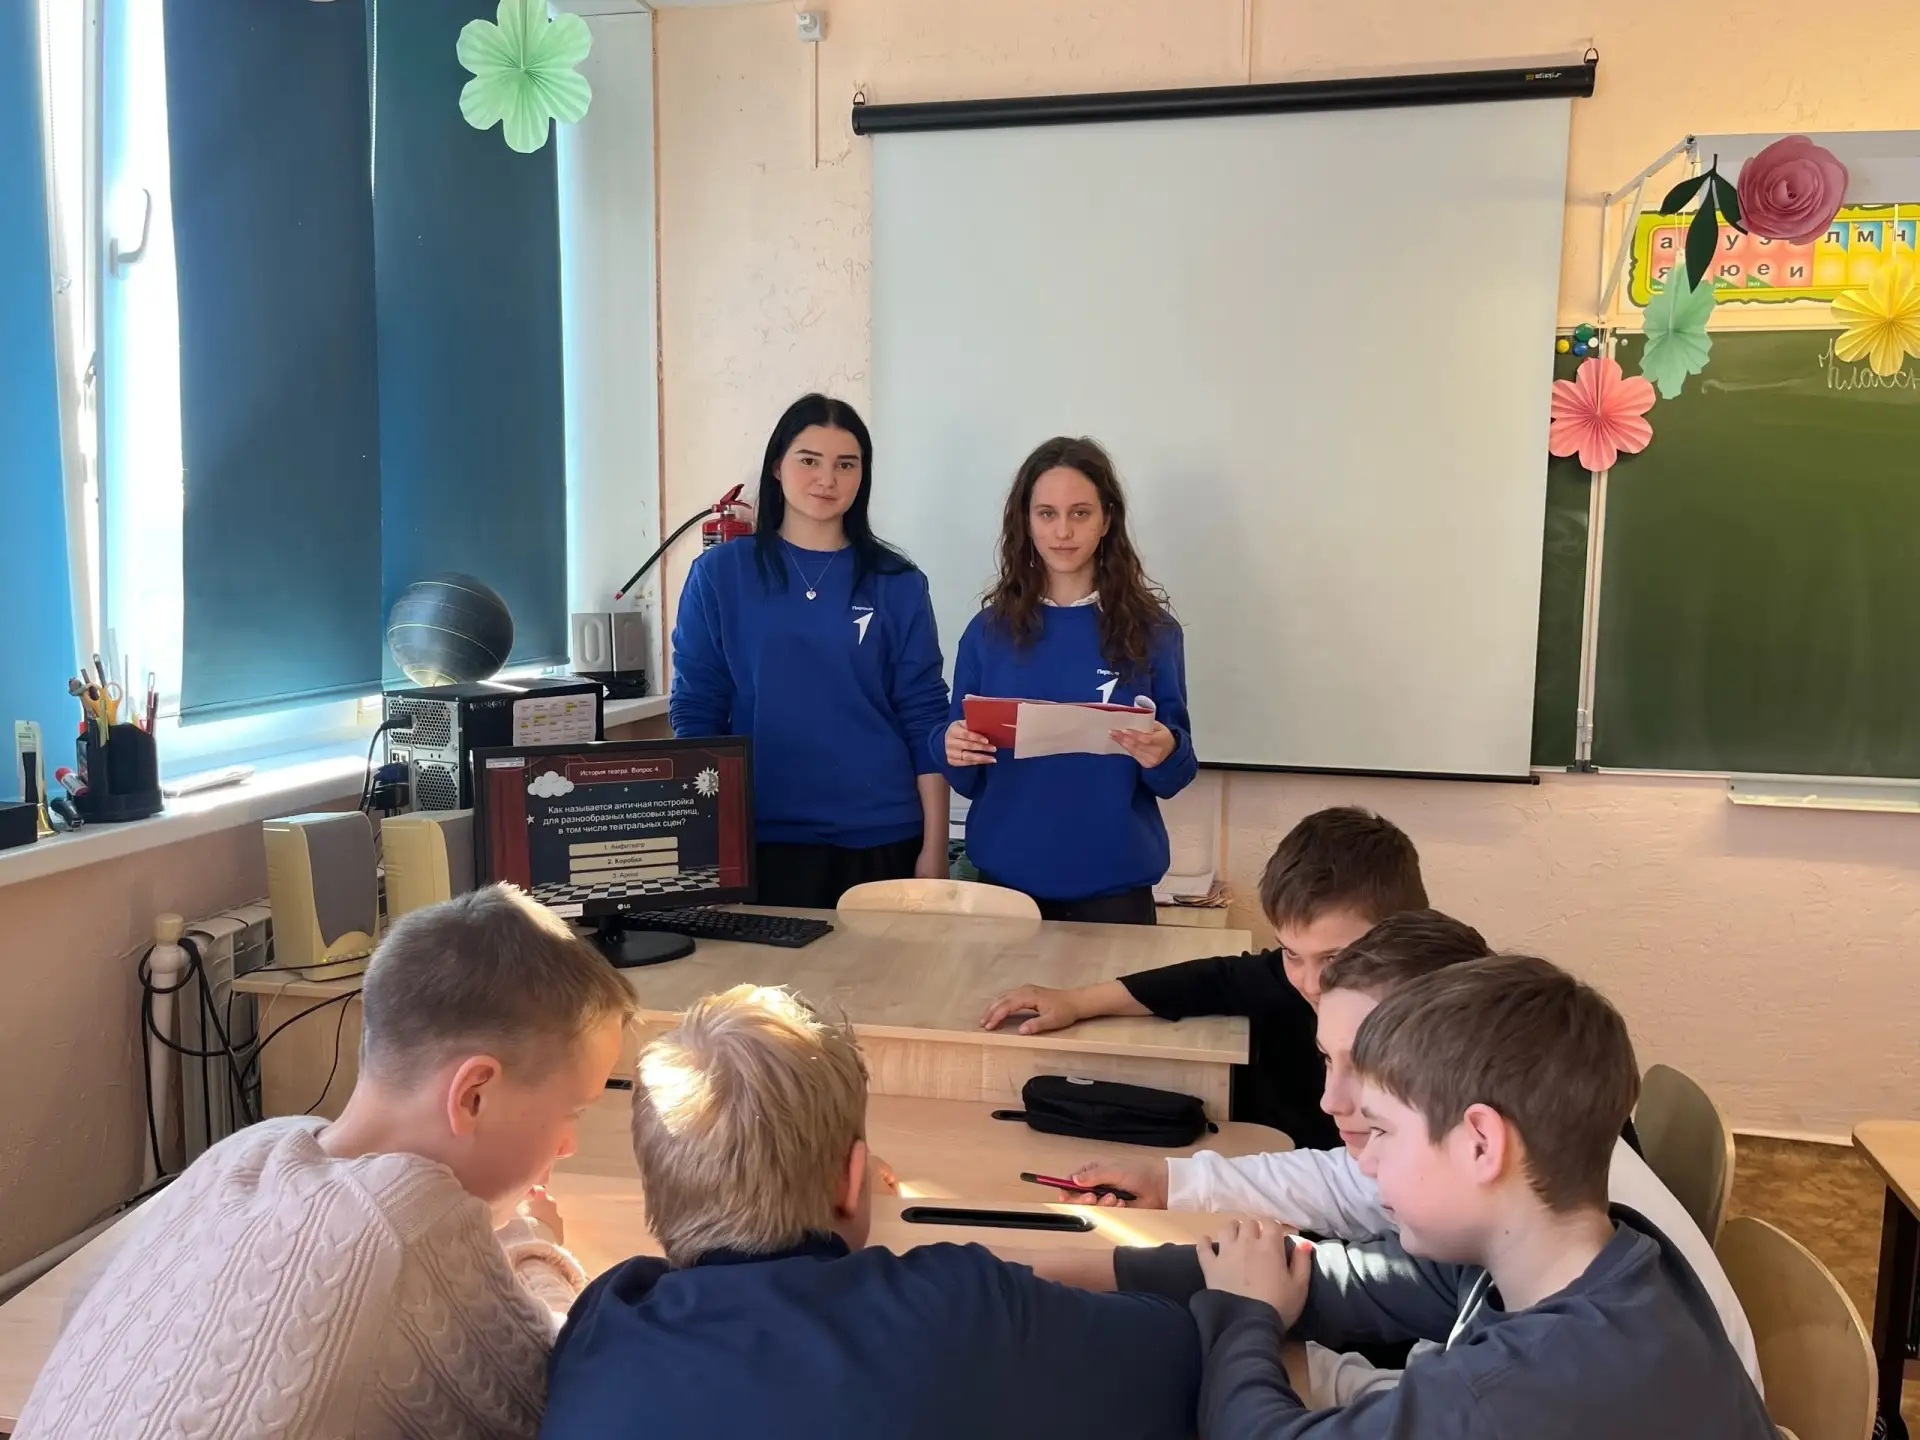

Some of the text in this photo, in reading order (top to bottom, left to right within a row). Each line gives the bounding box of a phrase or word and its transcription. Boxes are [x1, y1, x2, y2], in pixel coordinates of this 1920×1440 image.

[1660, 236, 1673, 249] а
[1726, 234, 1739, 250] у
[1824, 231, 1840, 243] л
[1857, 230, 1874, 242] м
[1720, 264, 1740, 277] ю
[1757, 263, 1770, 275] е
[1790, 265, 1803, 278] и
[580, 769, 606, 777] История
[608, 768, 628, 776] театра.
[631, 766, 653, 774] Вопрос
[548, 798, 695, 814] Как называется античная постройка
[542, 808, 700, 826] для разнообразных массовых зрелищ,
[565, 826, 582, 834] том
[582, 824, 608, 833] числе
[609, 821, 662, 832] театральных
[662, 817, 687, 828] сцен?
[614, 857, 642, 865] Коробка
